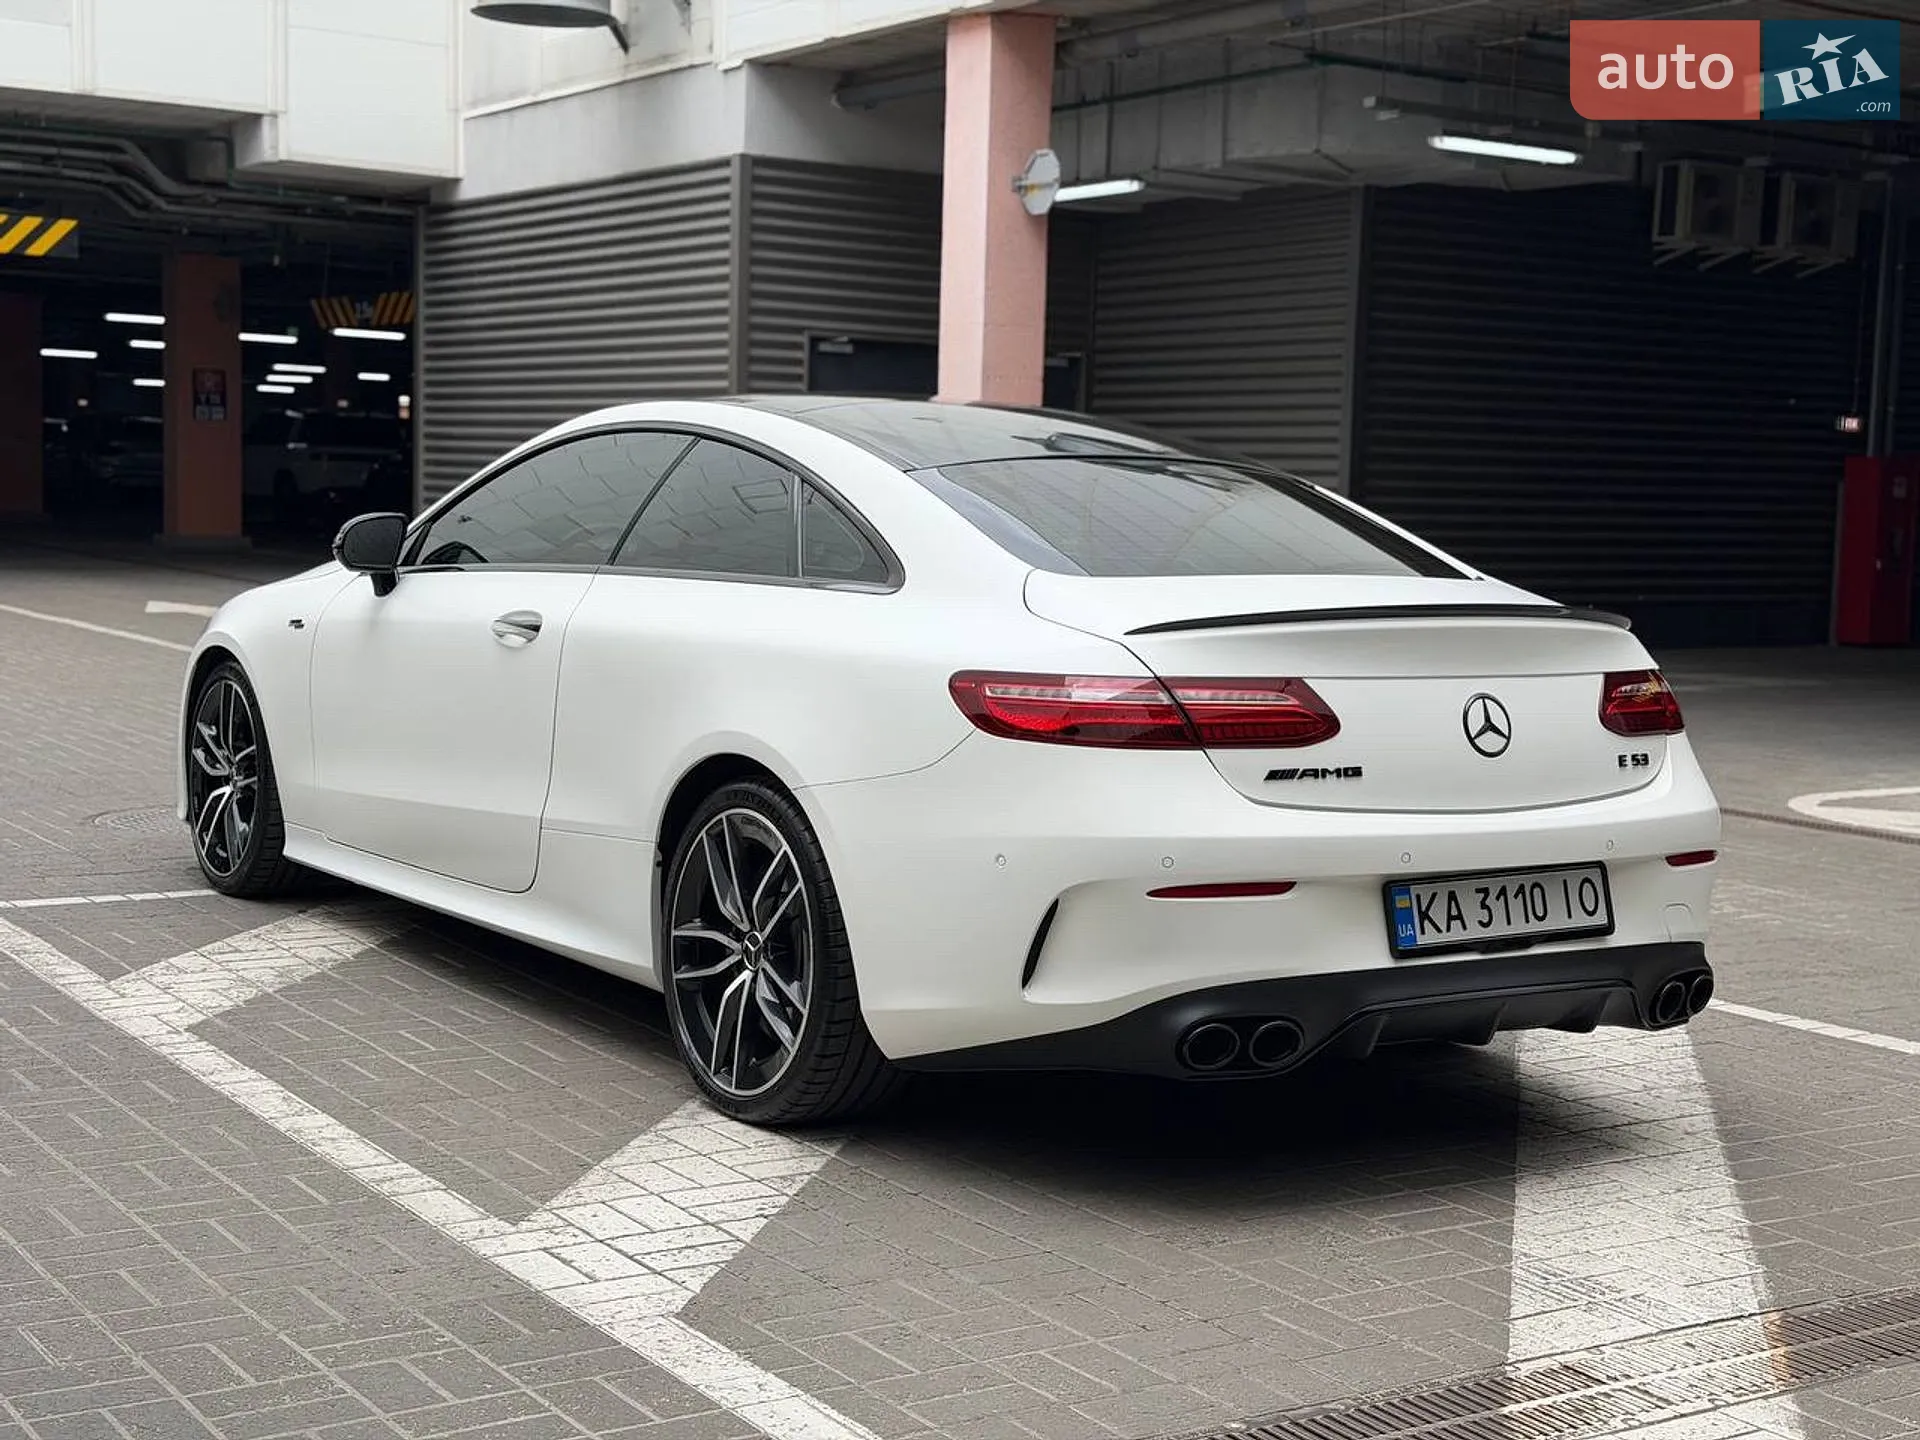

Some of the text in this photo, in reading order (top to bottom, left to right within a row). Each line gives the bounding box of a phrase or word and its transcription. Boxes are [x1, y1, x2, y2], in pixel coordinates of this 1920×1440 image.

[1617, 753, 1650, 769] E 53
[1416, 877, 1600, 935] KA 3110 IO
[1398, 923, 1415, 938] UA
